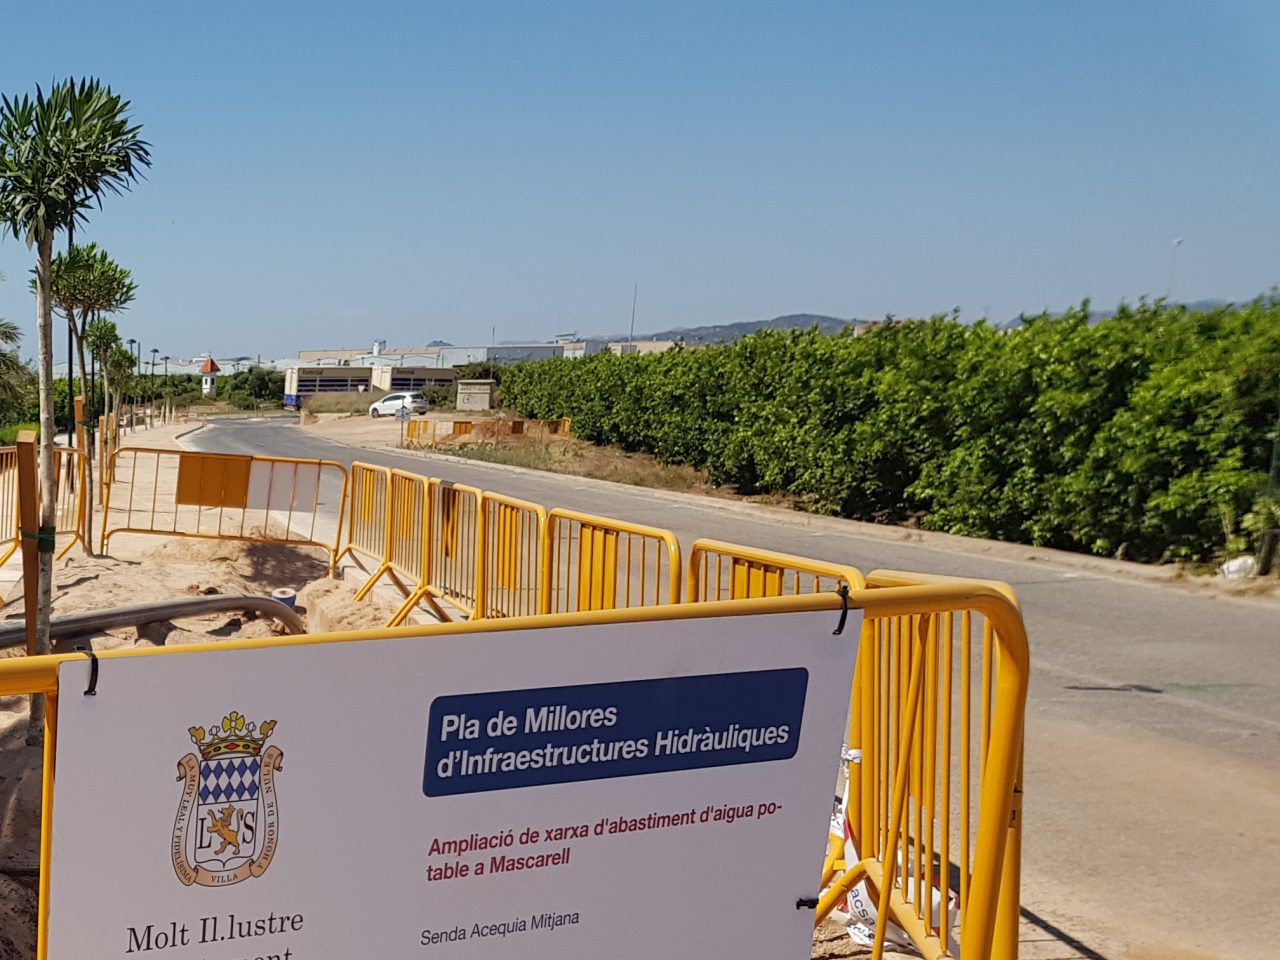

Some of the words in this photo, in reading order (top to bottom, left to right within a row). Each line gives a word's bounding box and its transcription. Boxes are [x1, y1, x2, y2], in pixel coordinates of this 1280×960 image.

[440, 714, 480, 742] Pla
[486, 711, 518, 738] de
[524, 705, 617, 734] Millores
[654, 724, 789, 756] Hidràuliques
[186, 775, 196, 797] MUY
[263, 753, 274, 794] NULES
[267, 801, 275, 817] DE
[197, 817, 213, 850] L
[262, 822, 275, 861] HONOR
[428, 829, 514, 857] Ampliació
[519, 827, 540, 845] de
[544, 824, 589, 842] xarxa
[593, 809, 696, 835] d'abastiment
[700, 804, 754, 823] d'aigua
[757, 802, 783, 820] po-
[211, 873, 238, 883] VILLA
[426, 861, 469, 882] table
[474, 862, 484, 876] a
[489, 847, 571, 874] Mascarell
[125, 922, 190, 953] Molt
[420, 926, 466, 946] Senda
[470, 917, 527, 938] Acequia
[530, 911, 580, 931] Mitjana
